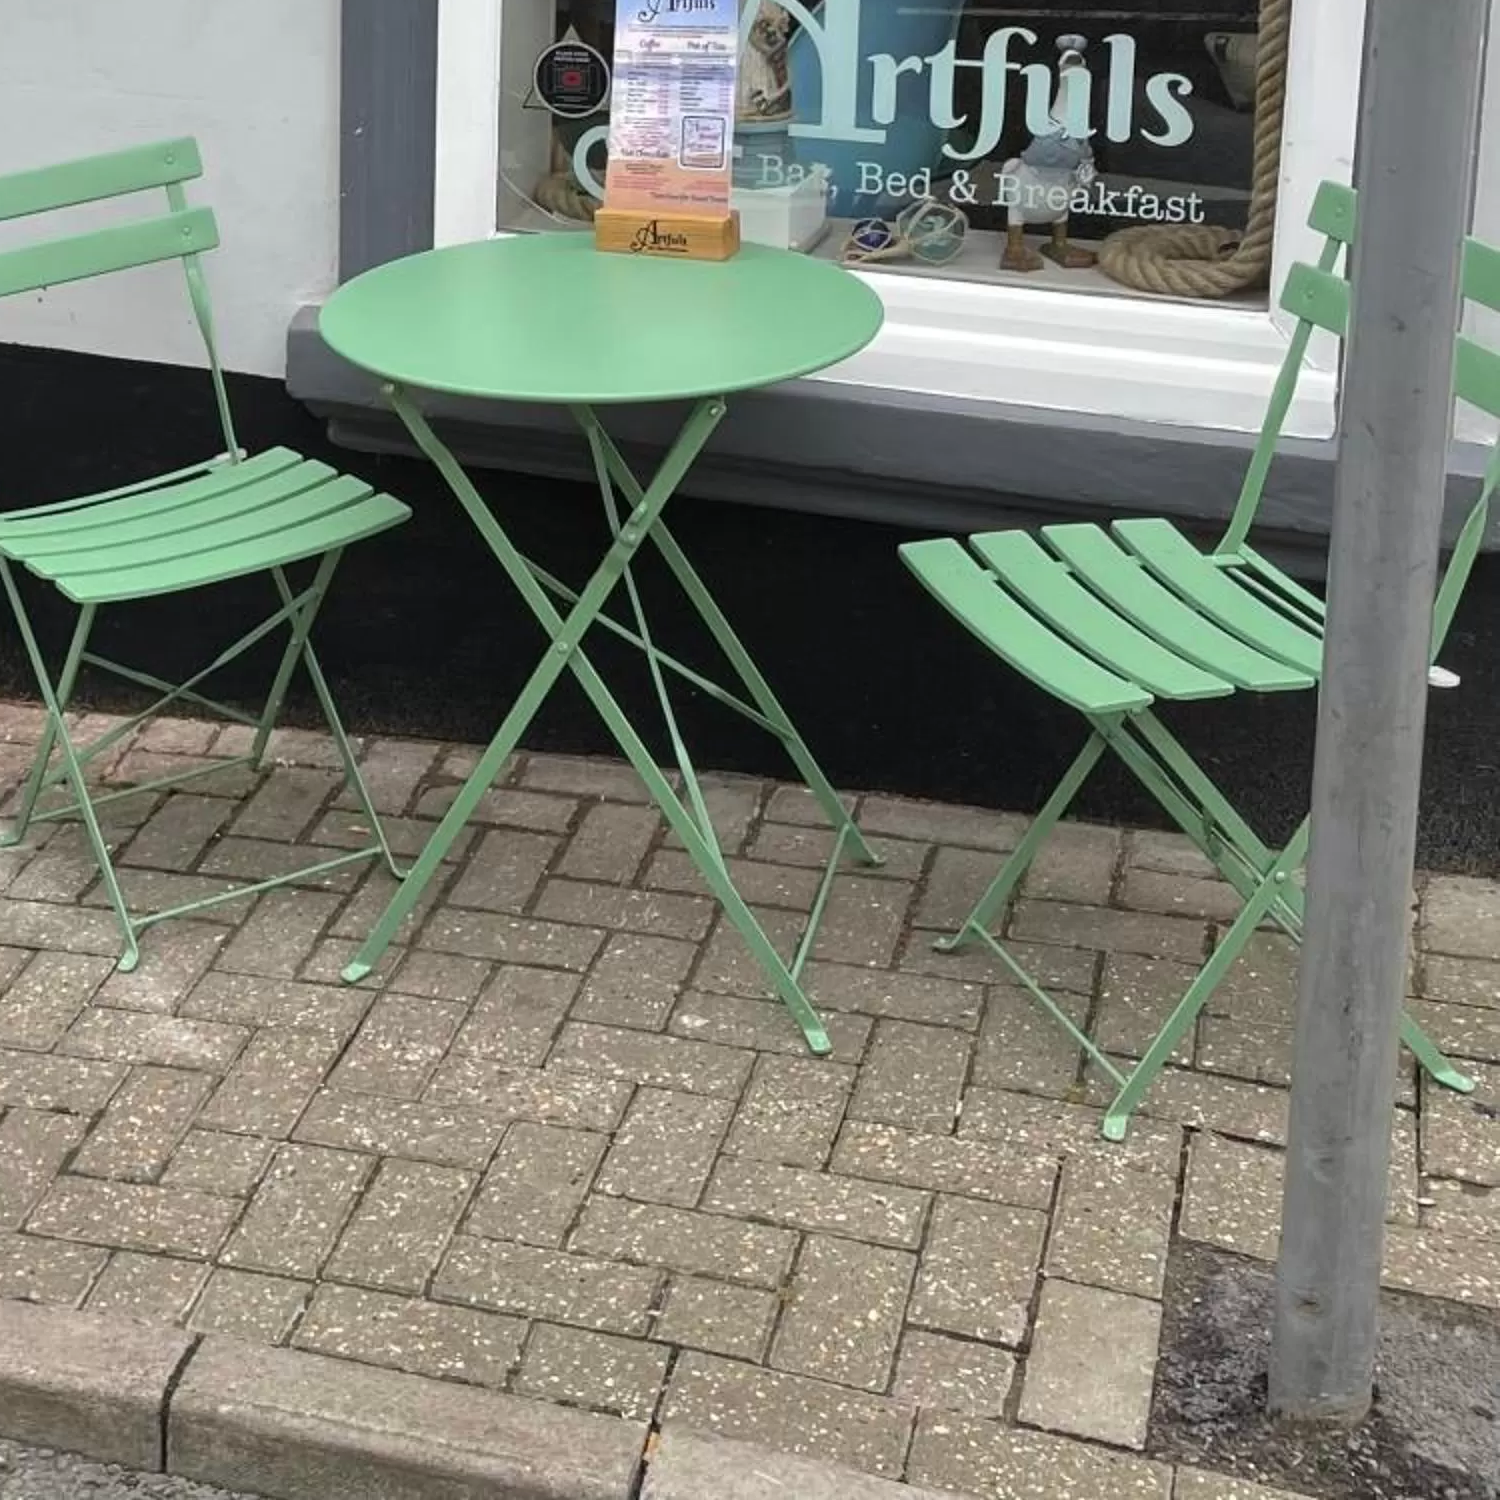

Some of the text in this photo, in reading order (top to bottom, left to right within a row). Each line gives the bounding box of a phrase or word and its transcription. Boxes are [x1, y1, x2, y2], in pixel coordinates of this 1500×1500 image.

[855, 161, 935, 200] Bed
[950, 169, 979, 205] &
[992, 172, 1206, 224] Breakfast
